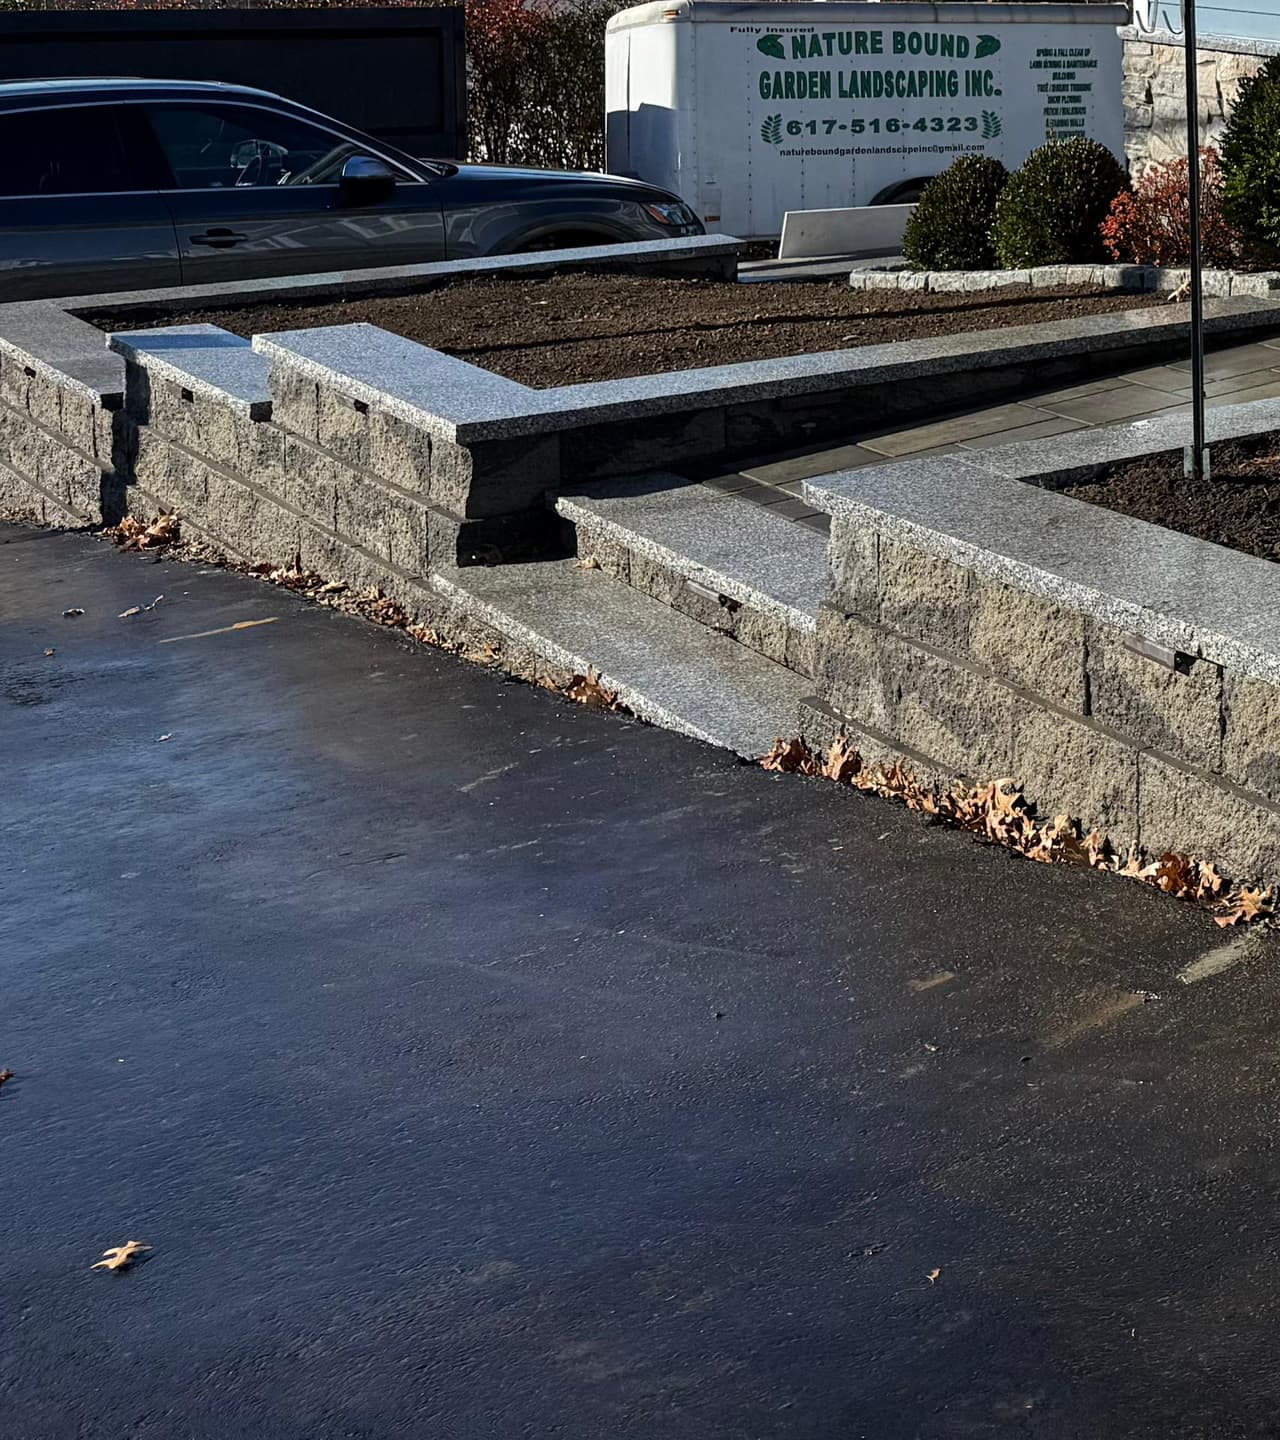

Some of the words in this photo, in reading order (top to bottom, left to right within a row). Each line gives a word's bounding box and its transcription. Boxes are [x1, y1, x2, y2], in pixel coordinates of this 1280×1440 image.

[730, 26, 761, 34] Fully
[791, 31, 884, 59] NATURE
[892, 31, 970, 58] BOUND
[759, 70, 832, 100] GARDEN
[838, 70, 959, 99] LANDSCAPING
[965, 69, 1002, 97] INC.
[786, 116, 979, 136] 617-516-4323
[779, 143, 985, 157] natureboundgardenlandscapeinc@gmail.com
